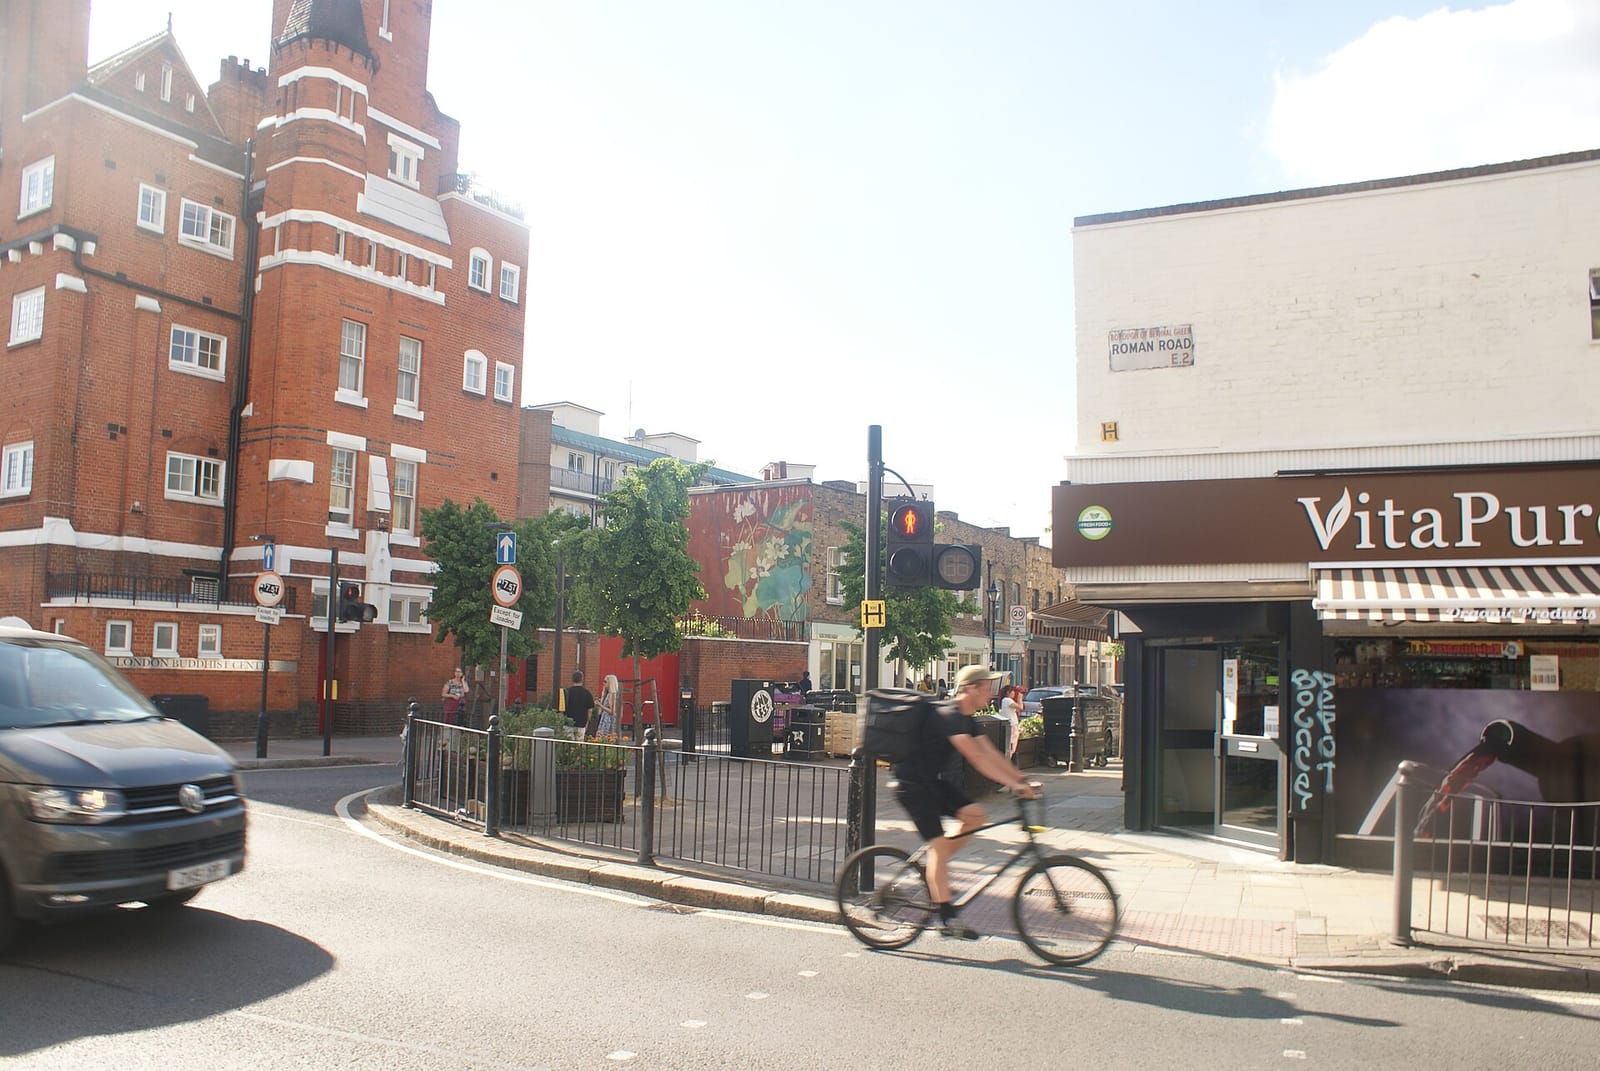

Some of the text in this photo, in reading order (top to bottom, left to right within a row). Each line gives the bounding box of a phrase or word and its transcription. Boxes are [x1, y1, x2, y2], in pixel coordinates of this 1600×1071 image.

[1112, 337, 1192, 355] ROMAN ROAD
[1171, 352, 1189, 365] E.2
[1297, 486, 1600, 551] VitaPur
[493, 606, 512, 618] Except
[1516, 607, 1597, 620] Products
[495, 614, 515, 626] loading
[116, 656, 169, 668] LONDON
[172, 658, 228, 669] BUDDHIST
